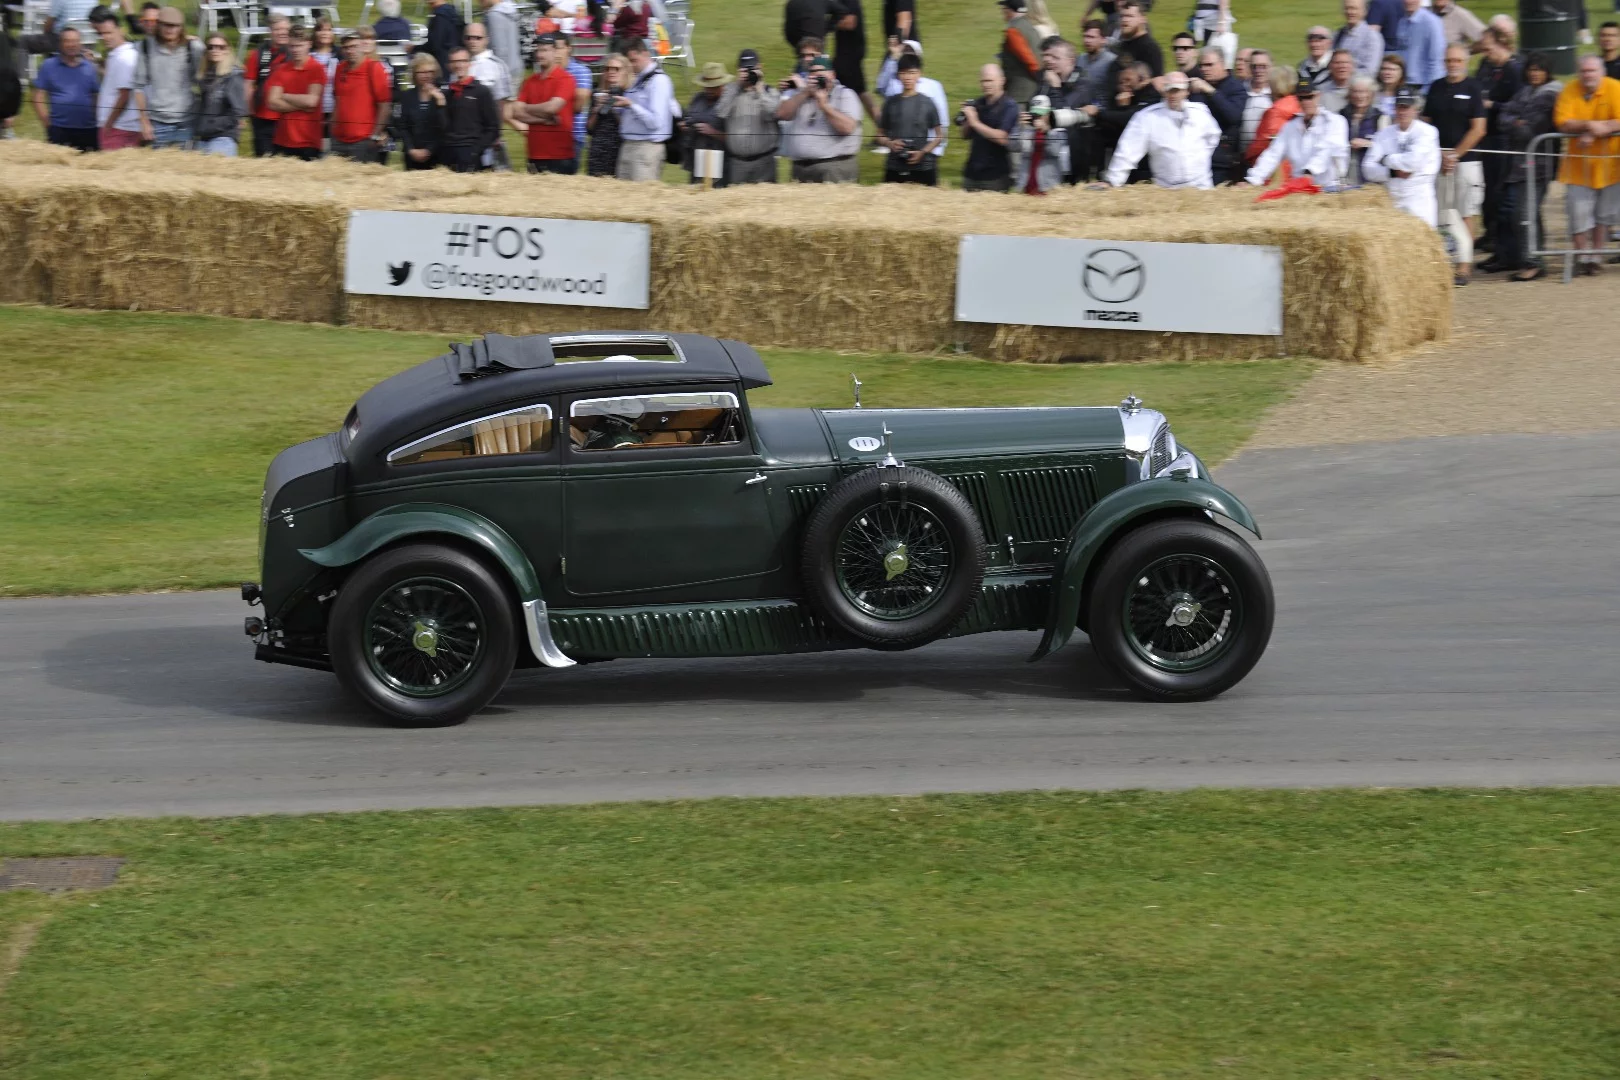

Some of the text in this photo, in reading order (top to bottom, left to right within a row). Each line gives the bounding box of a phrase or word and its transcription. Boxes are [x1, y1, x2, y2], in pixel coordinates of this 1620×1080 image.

[446, 222, 544, 261] #FOS
[422, 262, 607, 295] @fosgoodwood
[1084, 309, 1142, 323] mazda
